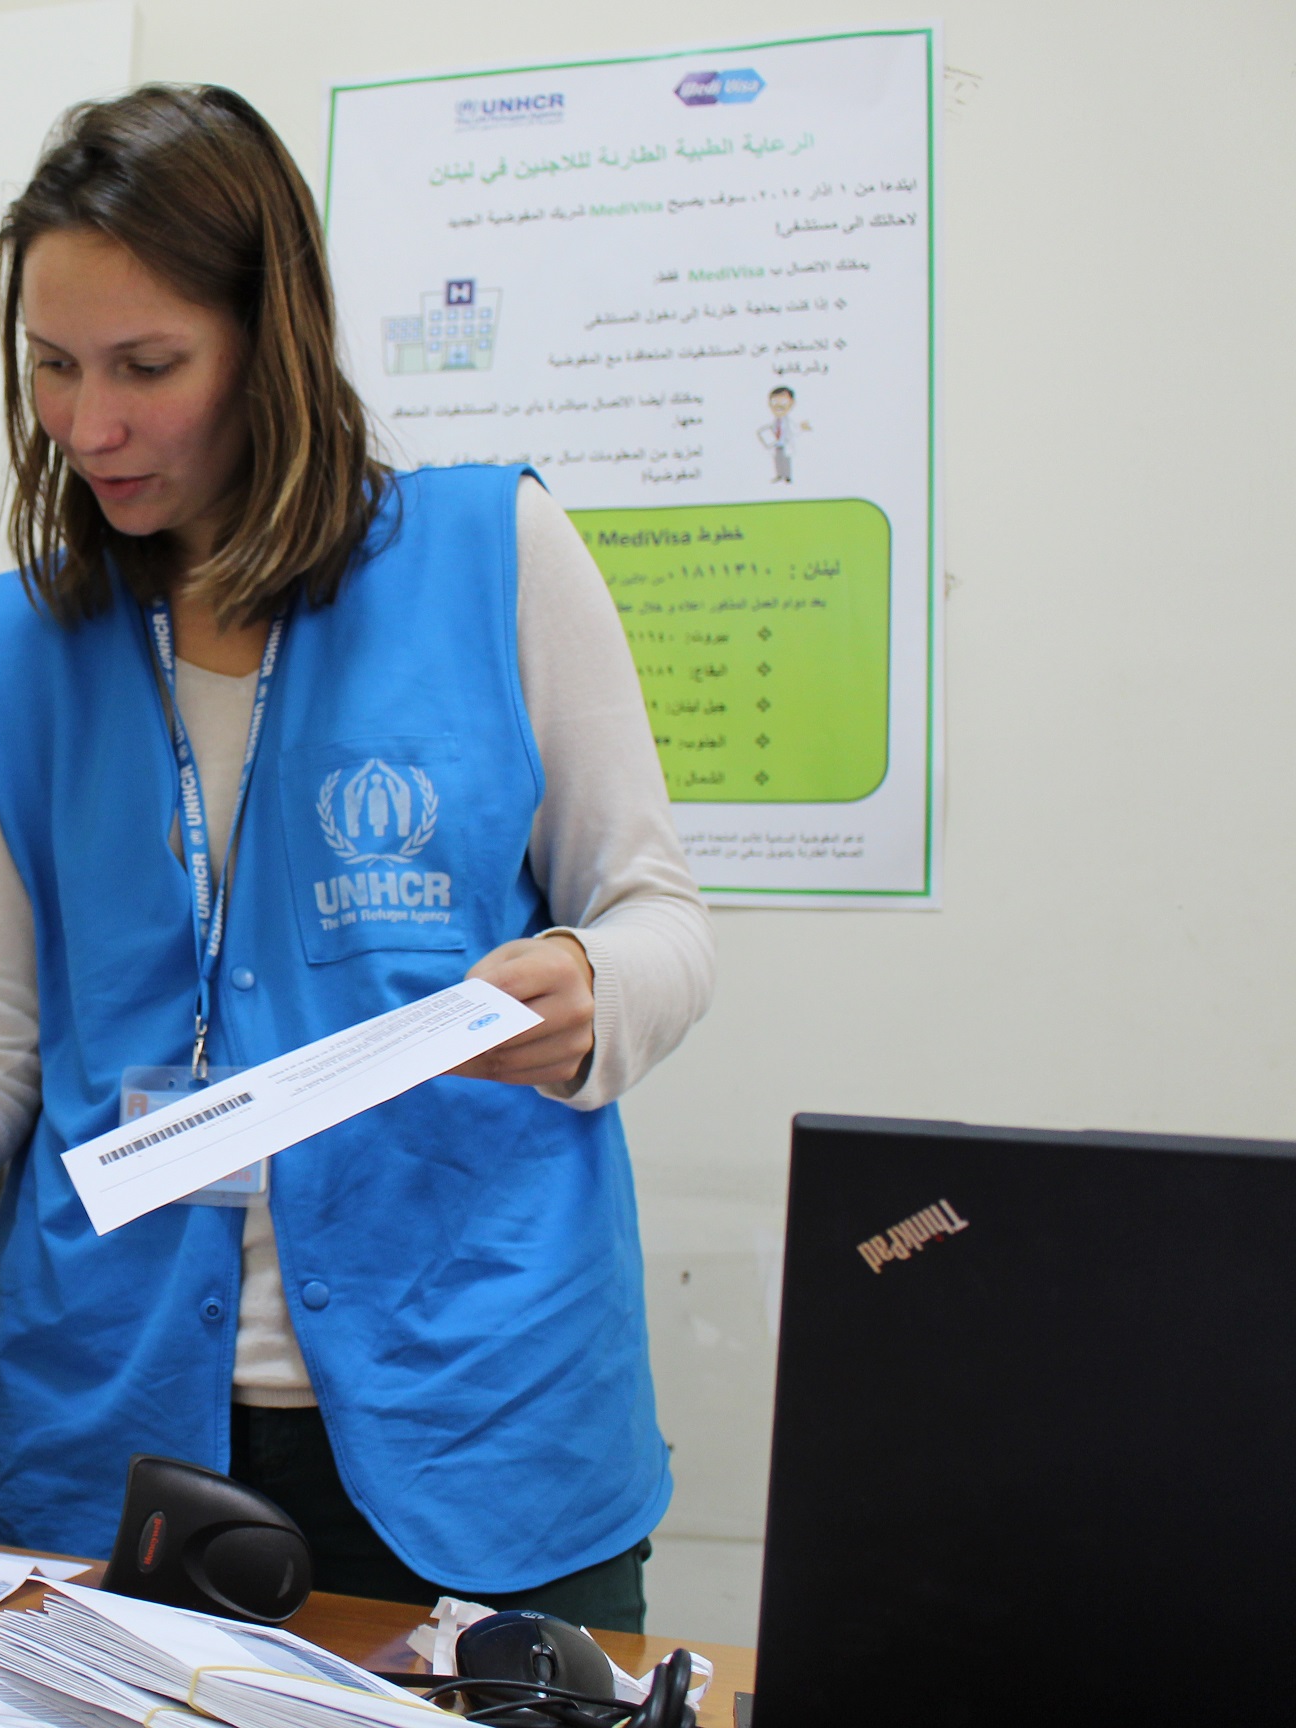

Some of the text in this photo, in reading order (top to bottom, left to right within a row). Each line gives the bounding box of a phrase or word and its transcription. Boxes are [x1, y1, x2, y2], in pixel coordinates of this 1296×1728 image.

[482, 92, 565, 114] UNHCR
[687, 264, 766, 282] MediVisa
[598, 530, 692, 548] MediVisa
[180, 763, 203, 828] UNHCR
[192, 852, 211, 920] UNHCR
[313, 871, 453, 916] UNHCR
[319, 907, 452, 931] The UN Refugee Agency
[856, 1198, 970, 1275] ThinkPad
